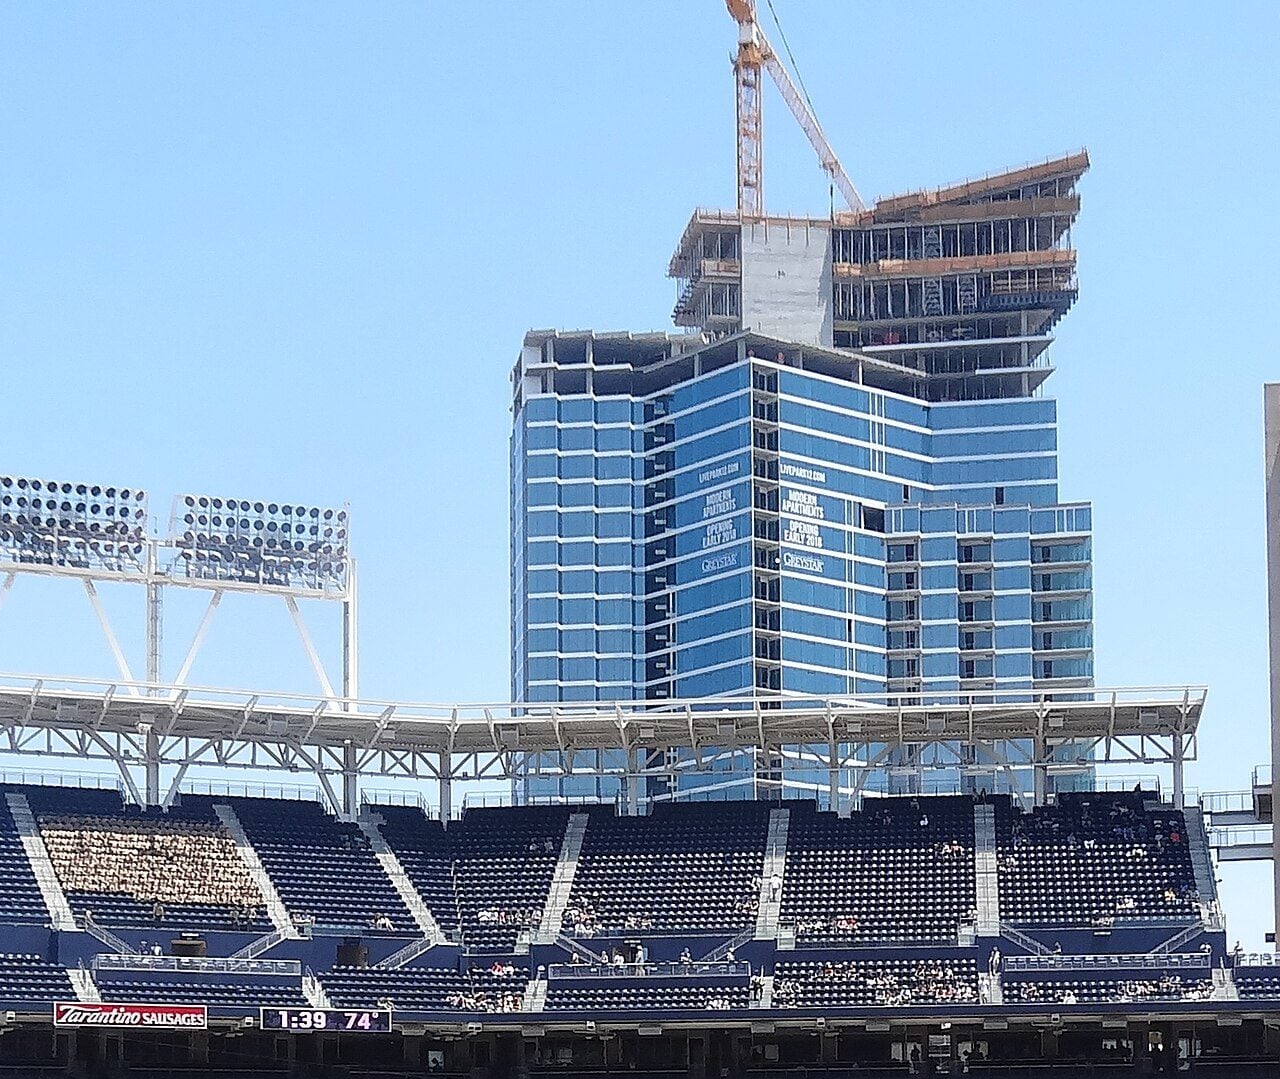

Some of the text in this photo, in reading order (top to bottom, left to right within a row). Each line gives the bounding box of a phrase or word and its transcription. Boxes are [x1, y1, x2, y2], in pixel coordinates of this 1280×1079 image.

[57, 1005, 204, 1025] Tarantino SAUSAGES
[279, 1011, 326, 1028] 1:39
